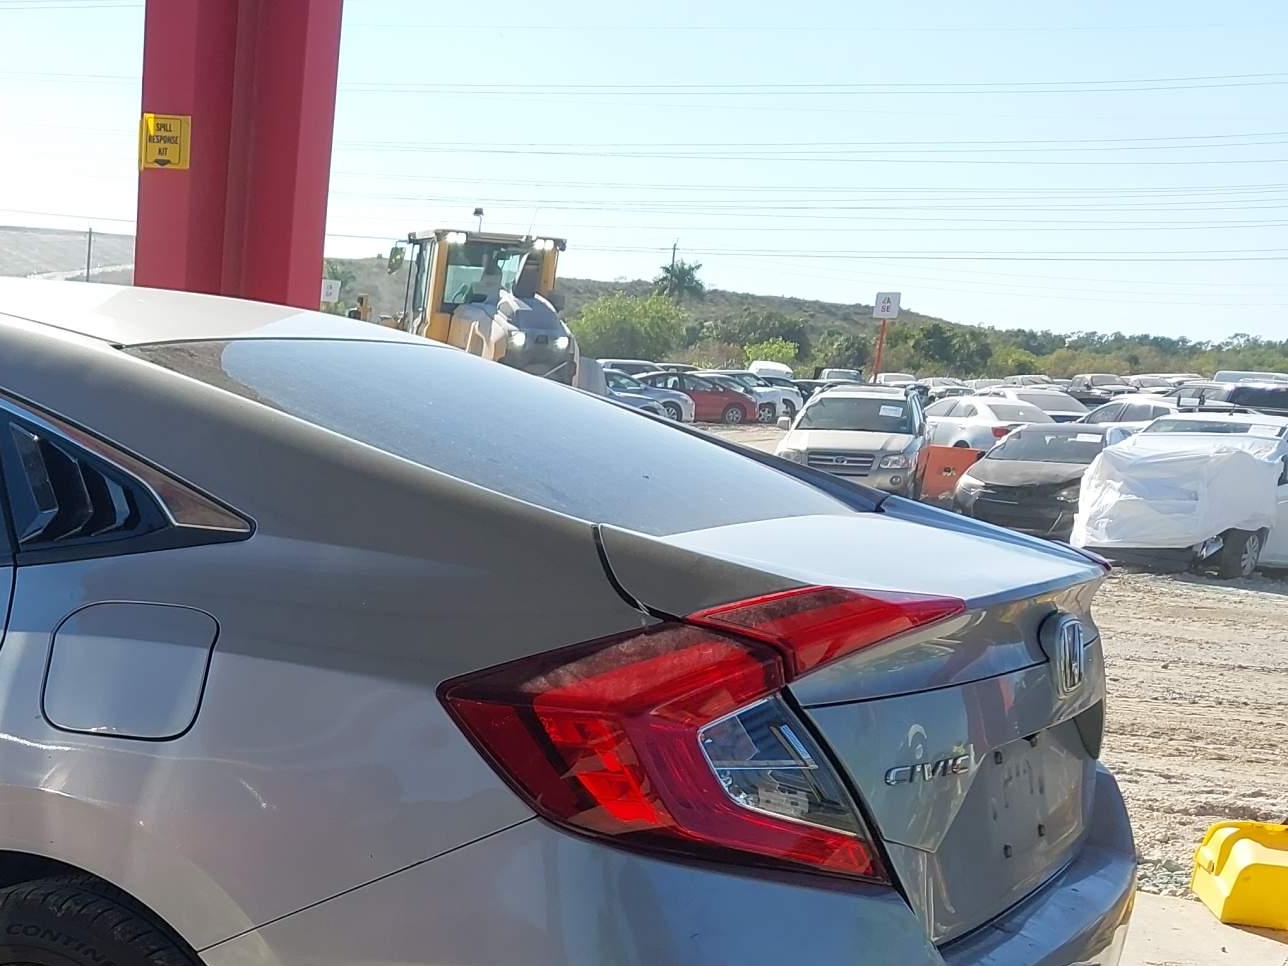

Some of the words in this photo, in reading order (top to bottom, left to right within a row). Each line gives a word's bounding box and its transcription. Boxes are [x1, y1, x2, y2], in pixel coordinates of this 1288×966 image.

[156, 122, 172, 132] SPILL
[148, 135, 179, 144] RESPONSE
[158, 147, 168, 156] KIT
[884, 753, 969, 787] CIVIC
